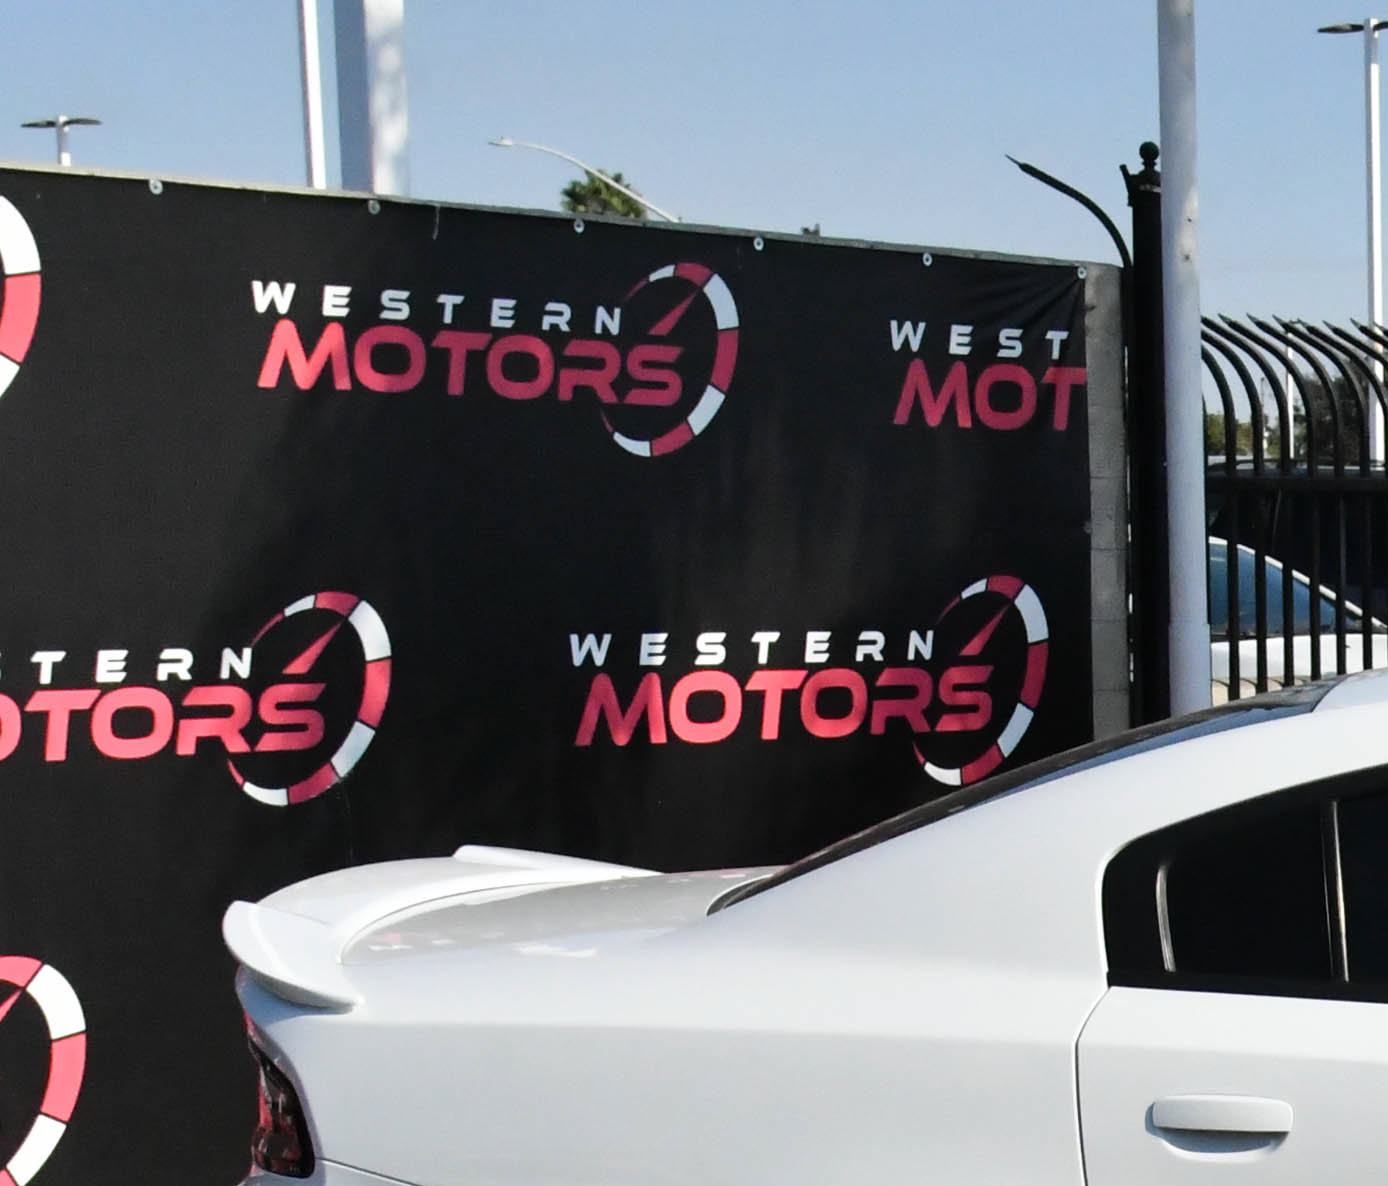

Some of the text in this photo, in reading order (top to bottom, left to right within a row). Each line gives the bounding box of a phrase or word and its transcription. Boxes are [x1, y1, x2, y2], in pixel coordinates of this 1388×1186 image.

[252, 279, 621, 336] WESTERN
[889, 319, 1069, 360] WEST
[256, 318, 684, 406] MOTORS
[893, 357, 1087, 431] MOT
[0, 647, 252, 685] TERN
[569, 630, 934, 667] WESTERN
[0, 682, 327, 762] TORS
[575, 665, 995, 747] MOTORS
